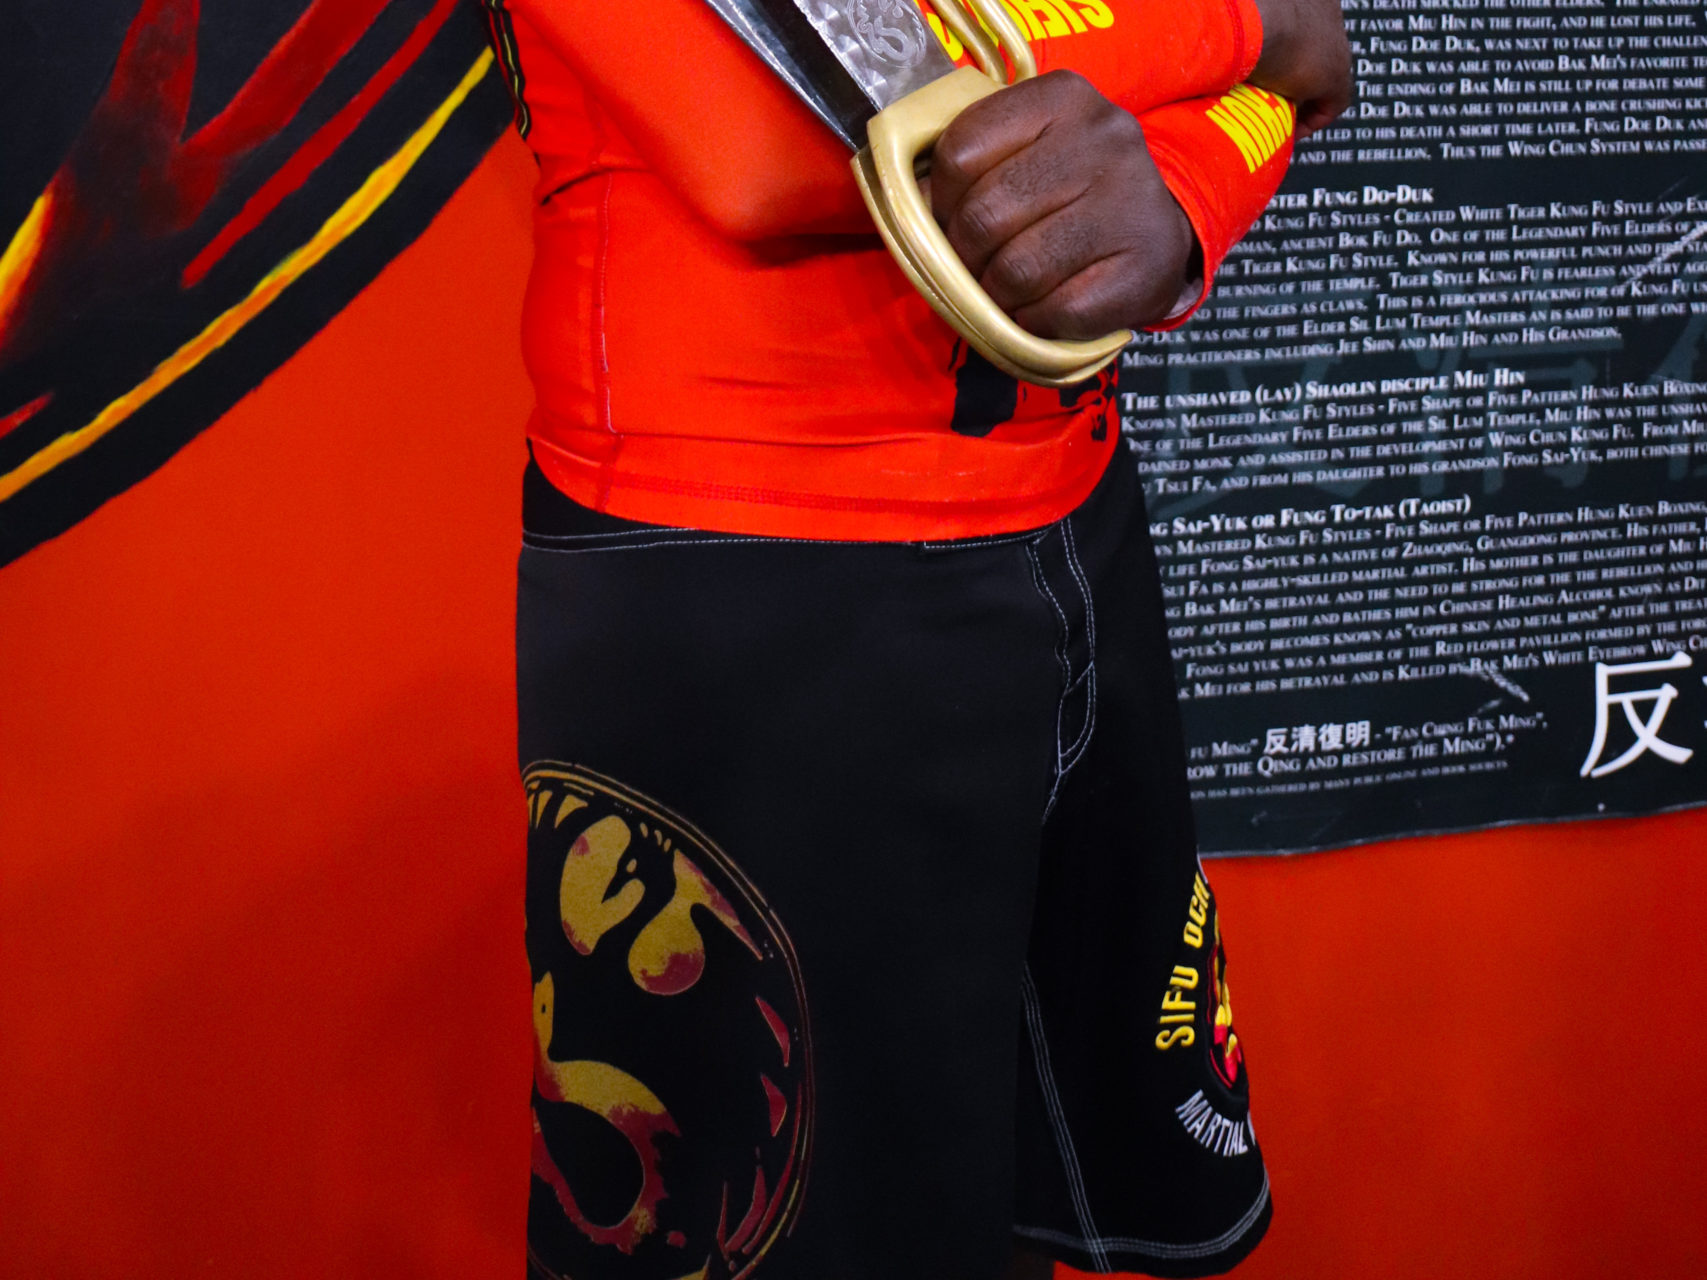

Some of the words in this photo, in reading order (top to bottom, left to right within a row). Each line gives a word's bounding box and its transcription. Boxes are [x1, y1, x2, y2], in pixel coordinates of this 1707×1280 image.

[1269, 193, 1307, 208] STER
[1312, 187, 1357, 206] FUNG
[1362, 184, 1433, 204] DO-DUK
[1122, 351, 1164, 366] MING
[1264, 343, 1334, 360] INCLUDING
[1336, 338, 1358, 355] JEE
[1362, 336, 1395, 352] SHIN
[1398, 336, 1427, 350] AND
[1429, 332, 1458, 348] MIU
[1461, 330, 1488, 346] HIN
[1491, 332, 1519, 344] AND
[1521, 327, 1545, 343] HIS
[1547, 326, 1622, 341] GRANDSON.
[1122, 392, 1159, 410] THE
[1164, 390, 1251, 408] UNSHAVED
[1254, 383, 1302, 404] (LAY)
[1305, 380, 1376, 399] SHAOLIN
[1380, 375, 1449, 393] DISCIPLE
[1453, 370, 1488, 387] MIU
[1493, 367, 1525, 386] HIN
[1172, 514, 1247, 534] SAI-YUK
[1251, 514, 1275, 528] OR
[1280, 508, 1326, 526] FUNG
[1331, 504, 1394, 521] TO-TAK
[1396, 494, 1471, 517] (TAOIST)
[1185, 662, 1224, 678] FONG
[1227, 661, 1249, 674] SAI
[1252, 659, 1280, 671] YUK
[1283, 656, 1313, 668] WAS
[1316, 655, 1326, 666] A
[1329, 650, 1384, 664] MEMBER
[1386, 648, 1403, 659] OF
[1408, 645, 1430, 658] THE
[1435, 640, 1464, 655] RED
[1466, 638, 1516, 652] FLOWER
[1519, 632, 1582, 647] PAVILLION
[1584, 626, 1634, 640] FORMED
[1636, 624, 1651, 636] BY
[1656, 621, 1677, 633] THE
[1579, 650, 1695, 779] 反
[1264, 721, 1371, 755] 反清復明
[1223, 761, 1252, 776] THE
[1256, 755, 1301, 776] QING
[1306, 755, 1338, 769] AND
[1341, 748, 1405, 766] RESTORE
[1410, 742, 1437, 758] THE
[1155, 965, 1200, 1050] SIFU
[1175, 1089, 1249, 1157] MARTIAL
